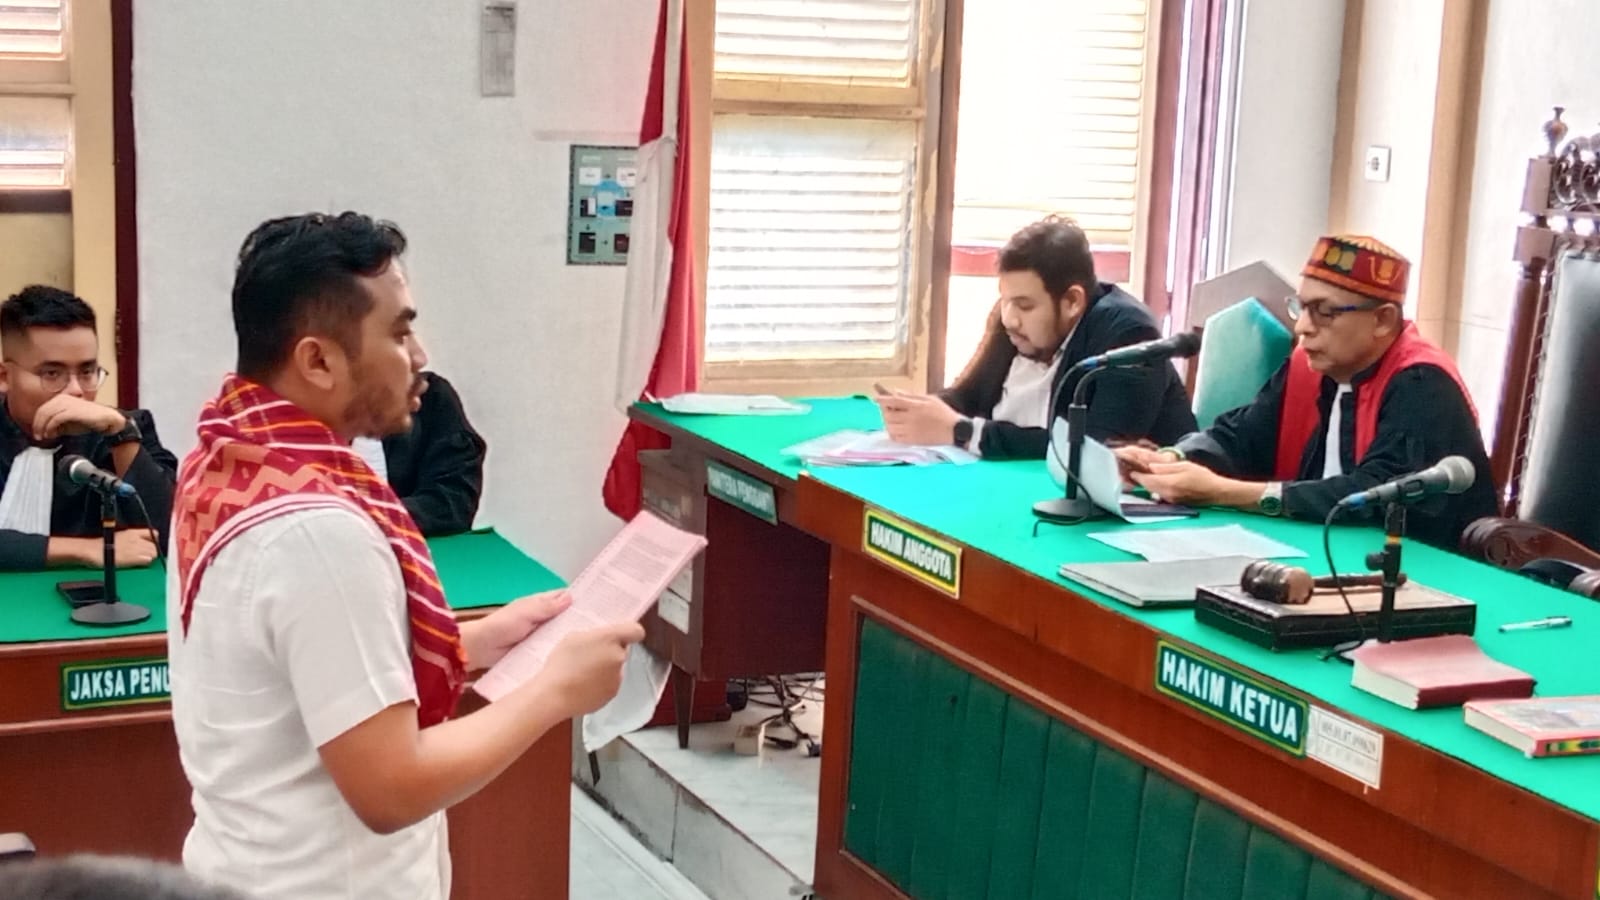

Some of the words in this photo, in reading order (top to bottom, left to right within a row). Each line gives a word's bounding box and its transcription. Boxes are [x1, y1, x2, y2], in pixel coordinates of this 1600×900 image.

[871, 521, 903, 556] HAKIM
[903, 537, 952, 581] ANGGOTA
[70, 669, 126, 700] JAKSA
[1162, 651, 1225, 708] HAKIM
[1229, 680, 1297, 742] KETUA
